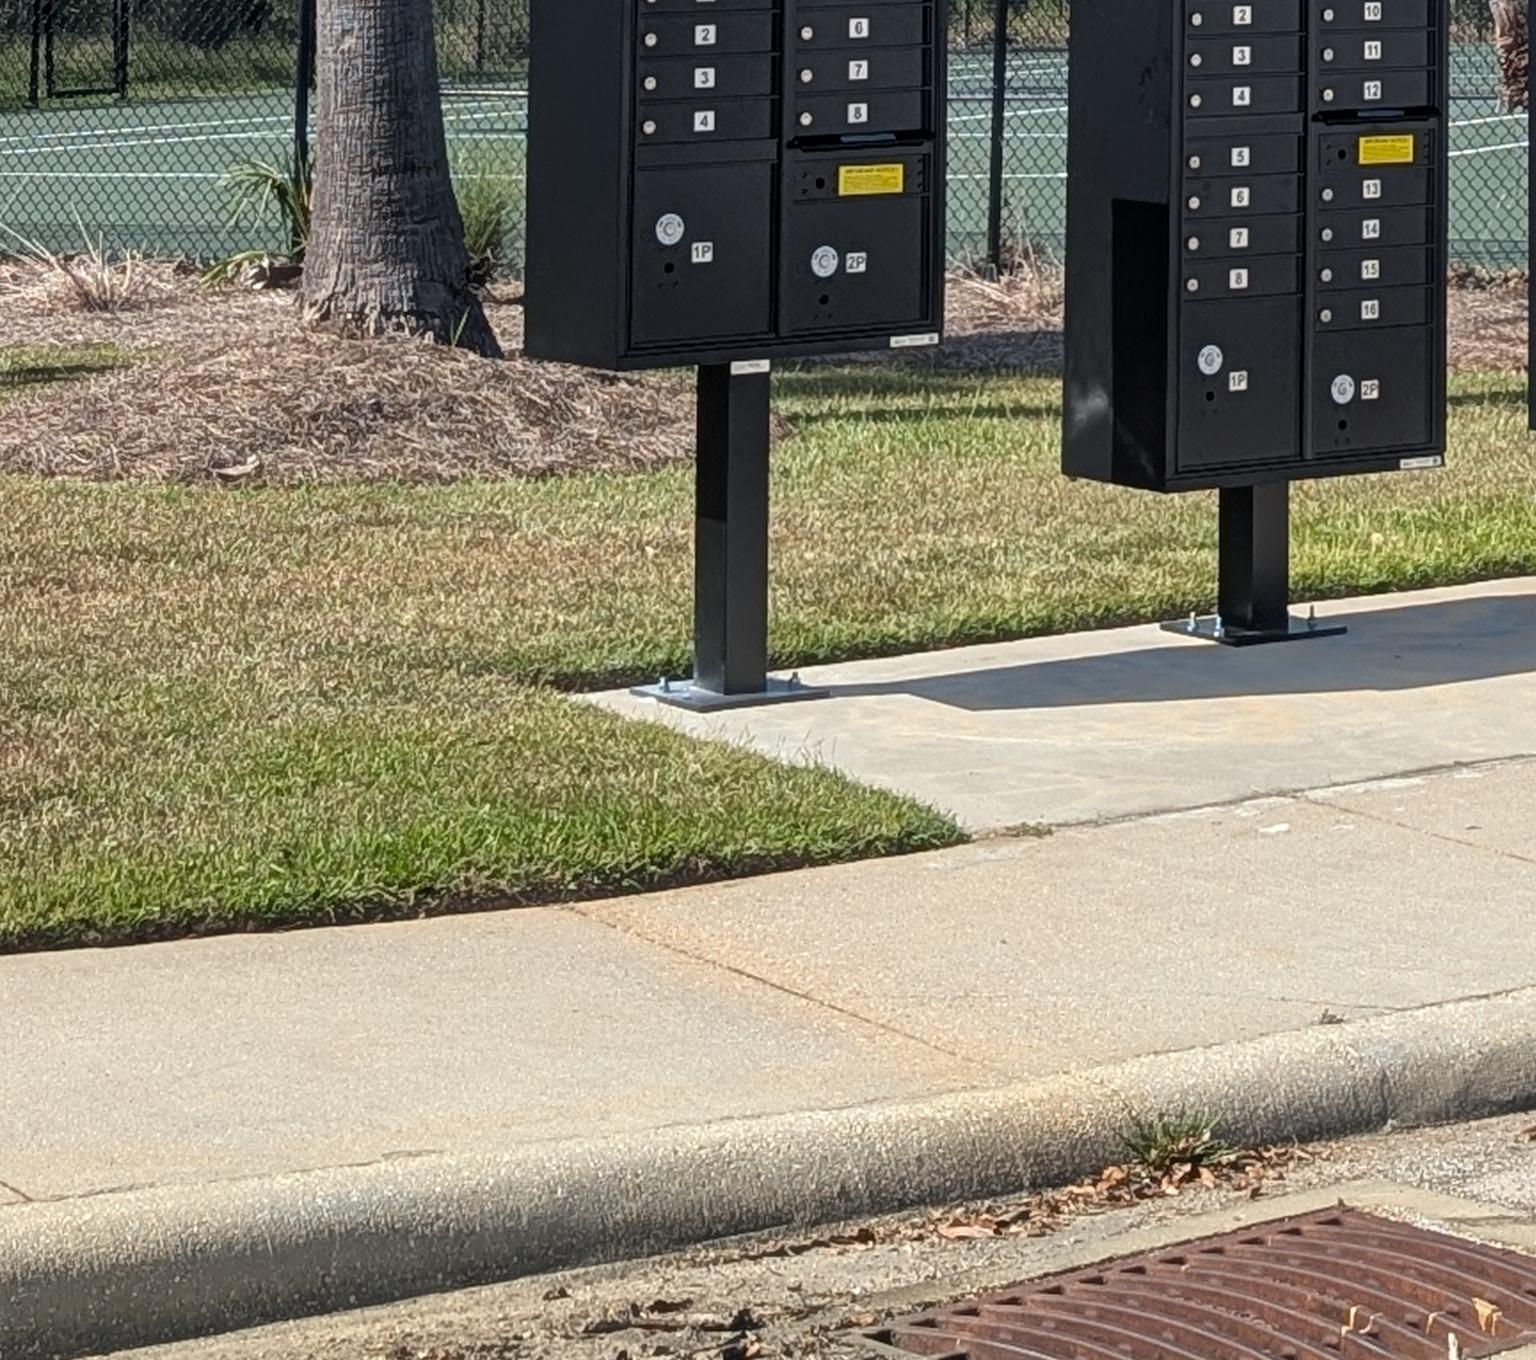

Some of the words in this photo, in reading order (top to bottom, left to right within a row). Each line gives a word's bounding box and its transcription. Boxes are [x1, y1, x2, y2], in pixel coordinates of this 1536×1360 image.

[1239, 9, 1246, 22] 2
[1366, 5, 1380, 17] 10
[701, 28, 710, 42] 2
[1238, 49, 1246, 62] 3
[1367, 44, 1378, 56] 11
[855, 63, 863, 77] 7
[701, 71, 710, 85] 3
[1238, 90, 1246, 102] 4
[1366, 84, 1379, 97] 12
[854, 106, 862, 120] 8
[700, 115, 708, 128] 4
[1237, 150, 1245, 163] 5
[1366, 182, 1378, 195] 13
[1236, 190, 1244, 204] 6
[1365, 223, 1378, 235] 14
[1236, 231, 1243, 244] 7
[694, 244, 711, 259] 1P
[847, 255, 865, 269] 2P
[1364, 263, 1378, 275] 15
[1235, 272, 1243, 286] 8
[1364, 303, 1376, 316] 16
[1231, 373, 1246, 387] 1P
[1362, 383, 1378, 396] 2P
